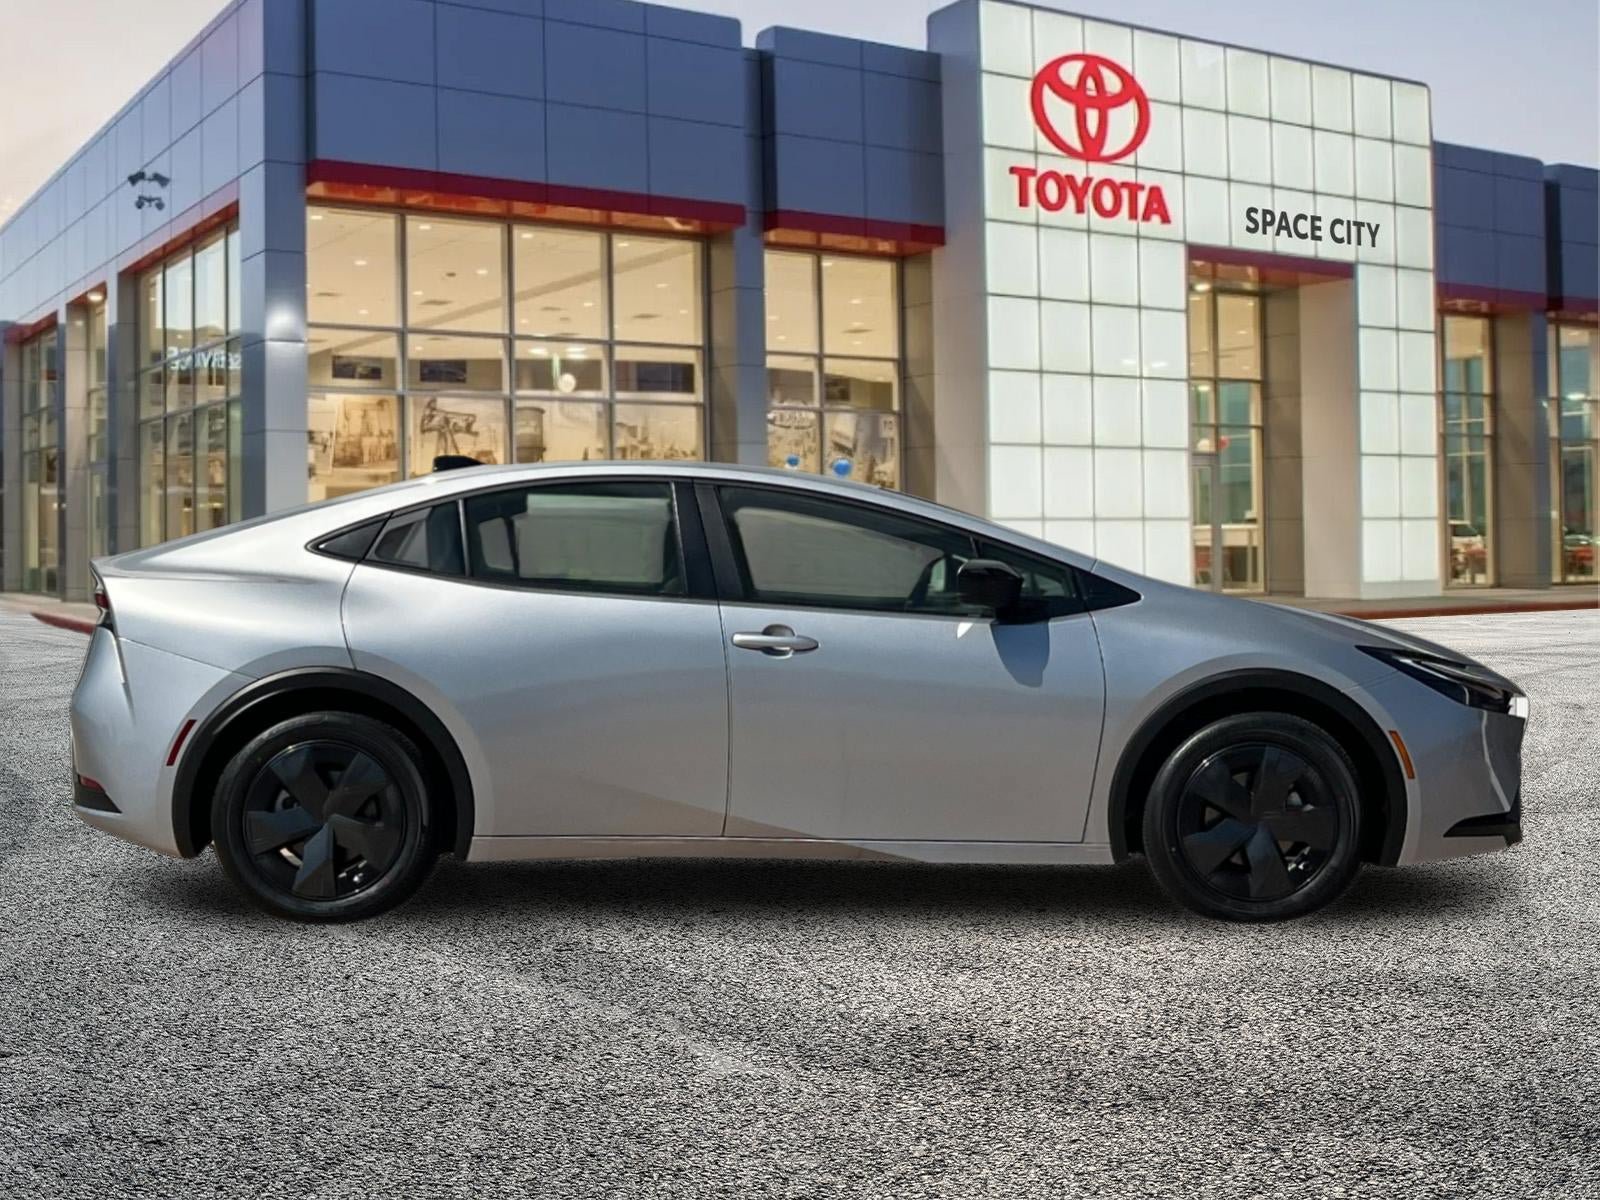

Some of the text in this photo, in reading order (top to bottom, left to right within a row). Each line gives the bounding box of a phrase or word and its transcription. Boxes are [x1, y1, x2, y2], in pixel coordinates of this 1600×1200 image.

[1009, 166, 1171, 225] TOYOTA
[1245, 207, 1380, 248] SPACE CITY
